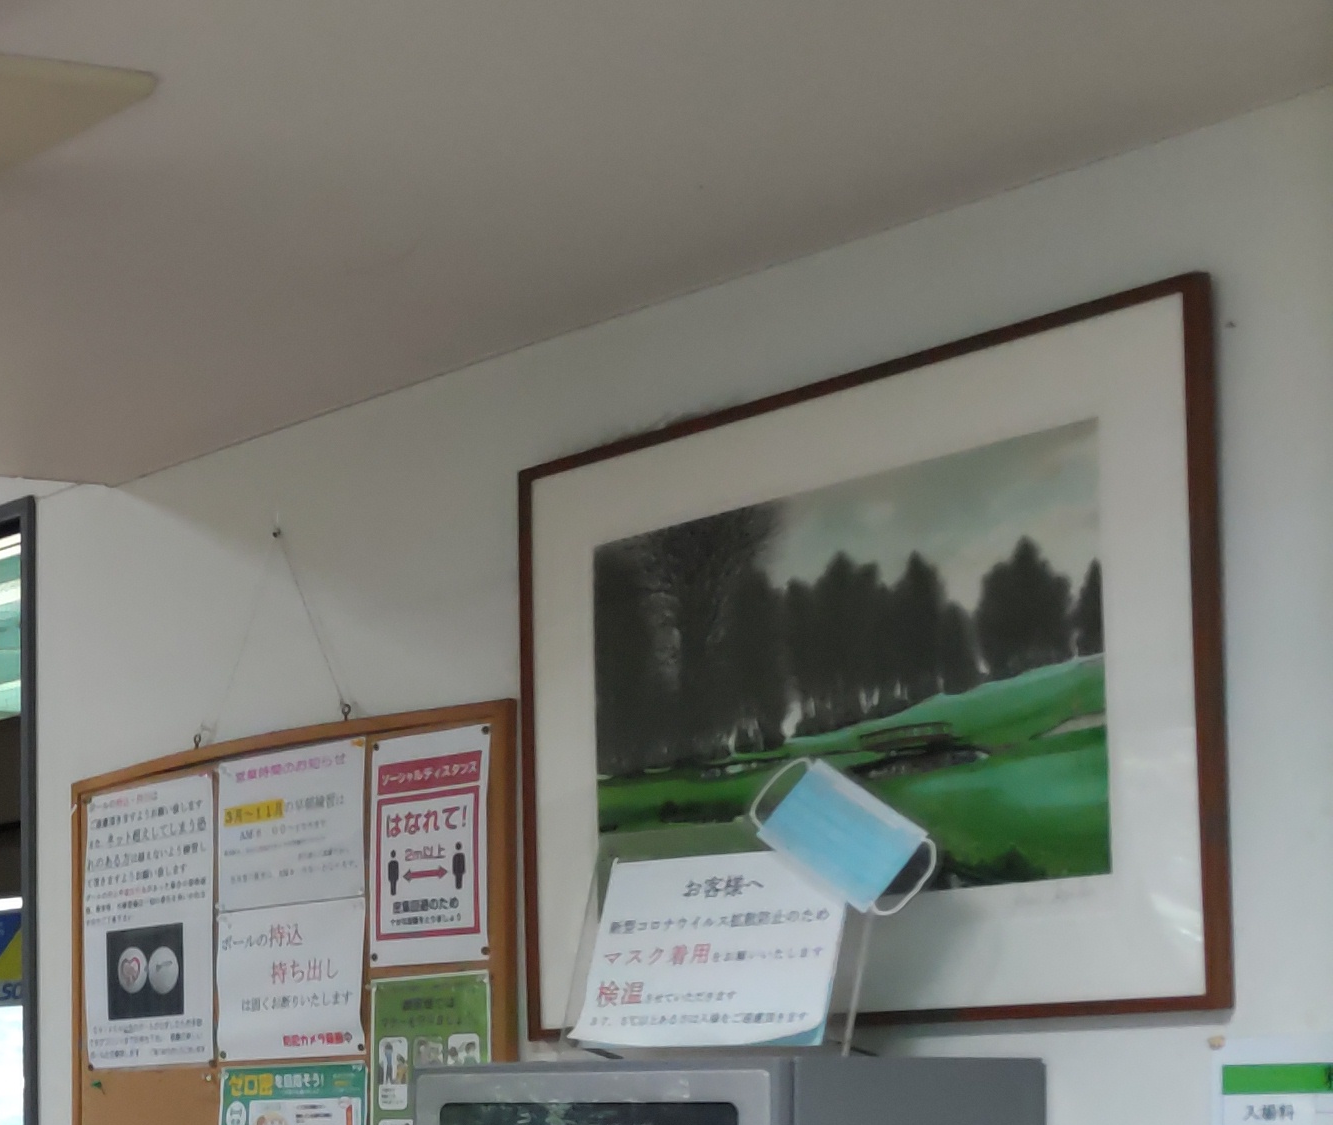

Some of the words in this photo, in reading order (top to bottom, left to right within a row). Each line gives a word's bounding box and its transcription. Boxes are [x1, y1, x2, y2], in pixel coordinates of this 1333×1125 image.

[382, 761, 478, 786] ソーシャルディスタンス
[386, 805, 468, 838] はなれて!
[683, 874, 764, 898] お客様へ
[222, 923, 304, 951] ボールの持込
[271, 958, 339, 985] 持ち出し
